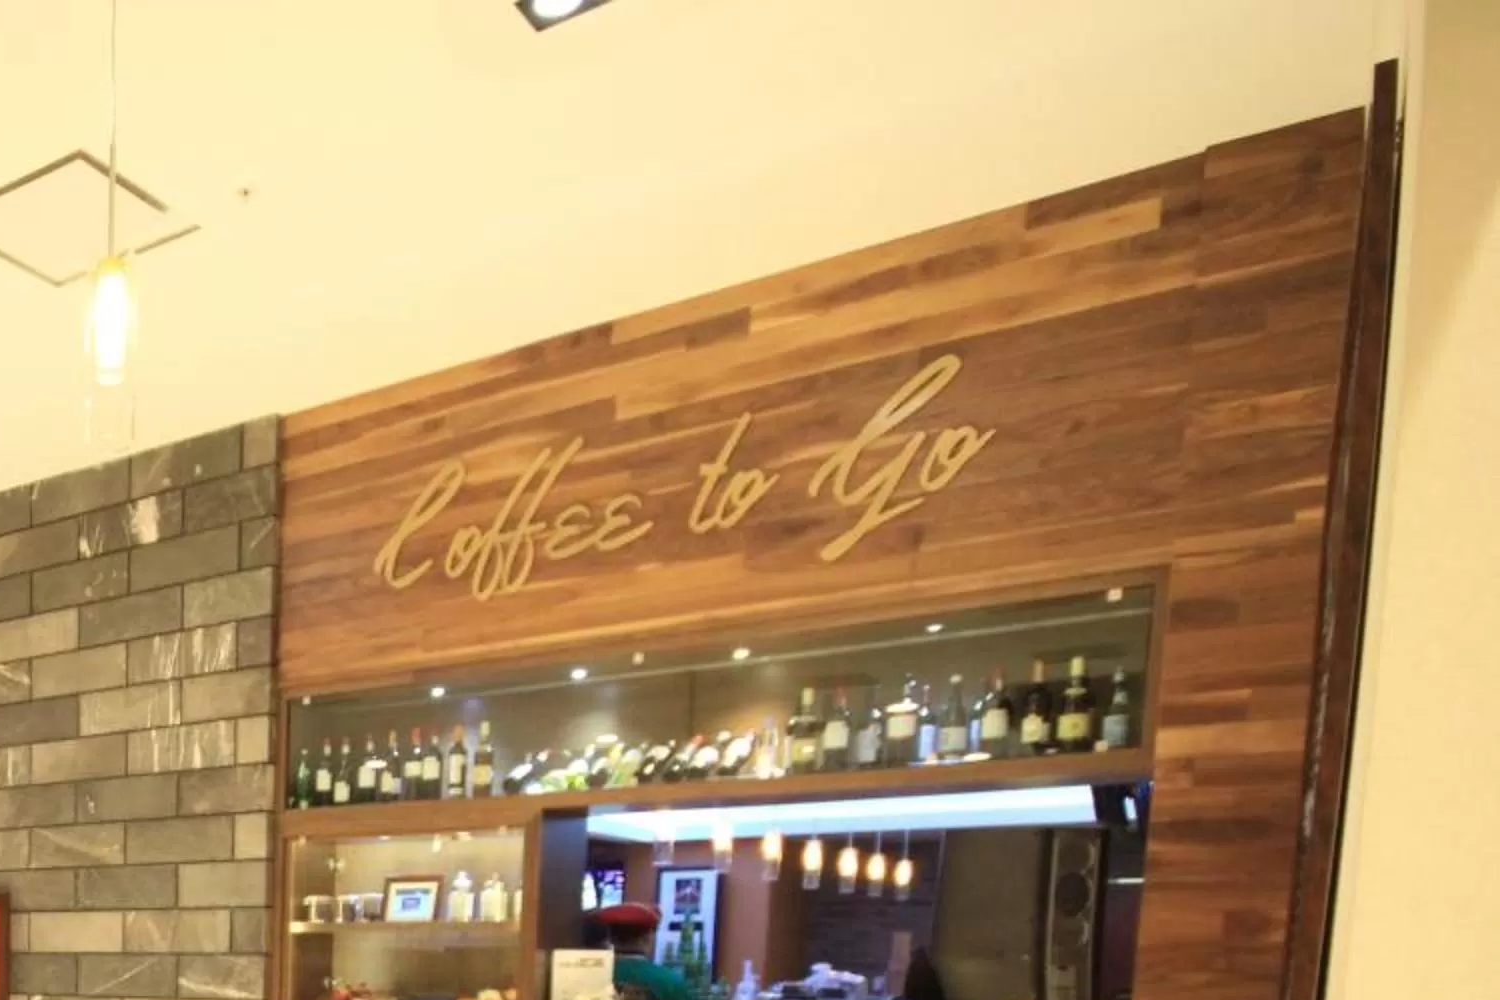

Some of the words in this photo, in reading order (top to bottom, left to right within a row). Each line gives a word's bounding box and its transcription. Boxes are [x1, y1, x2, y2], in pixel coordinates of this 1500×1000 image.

[373, 437, 655, 602] Coffee
[688, 412, 781, 535] to
[807, 354, 997, 562] Go
